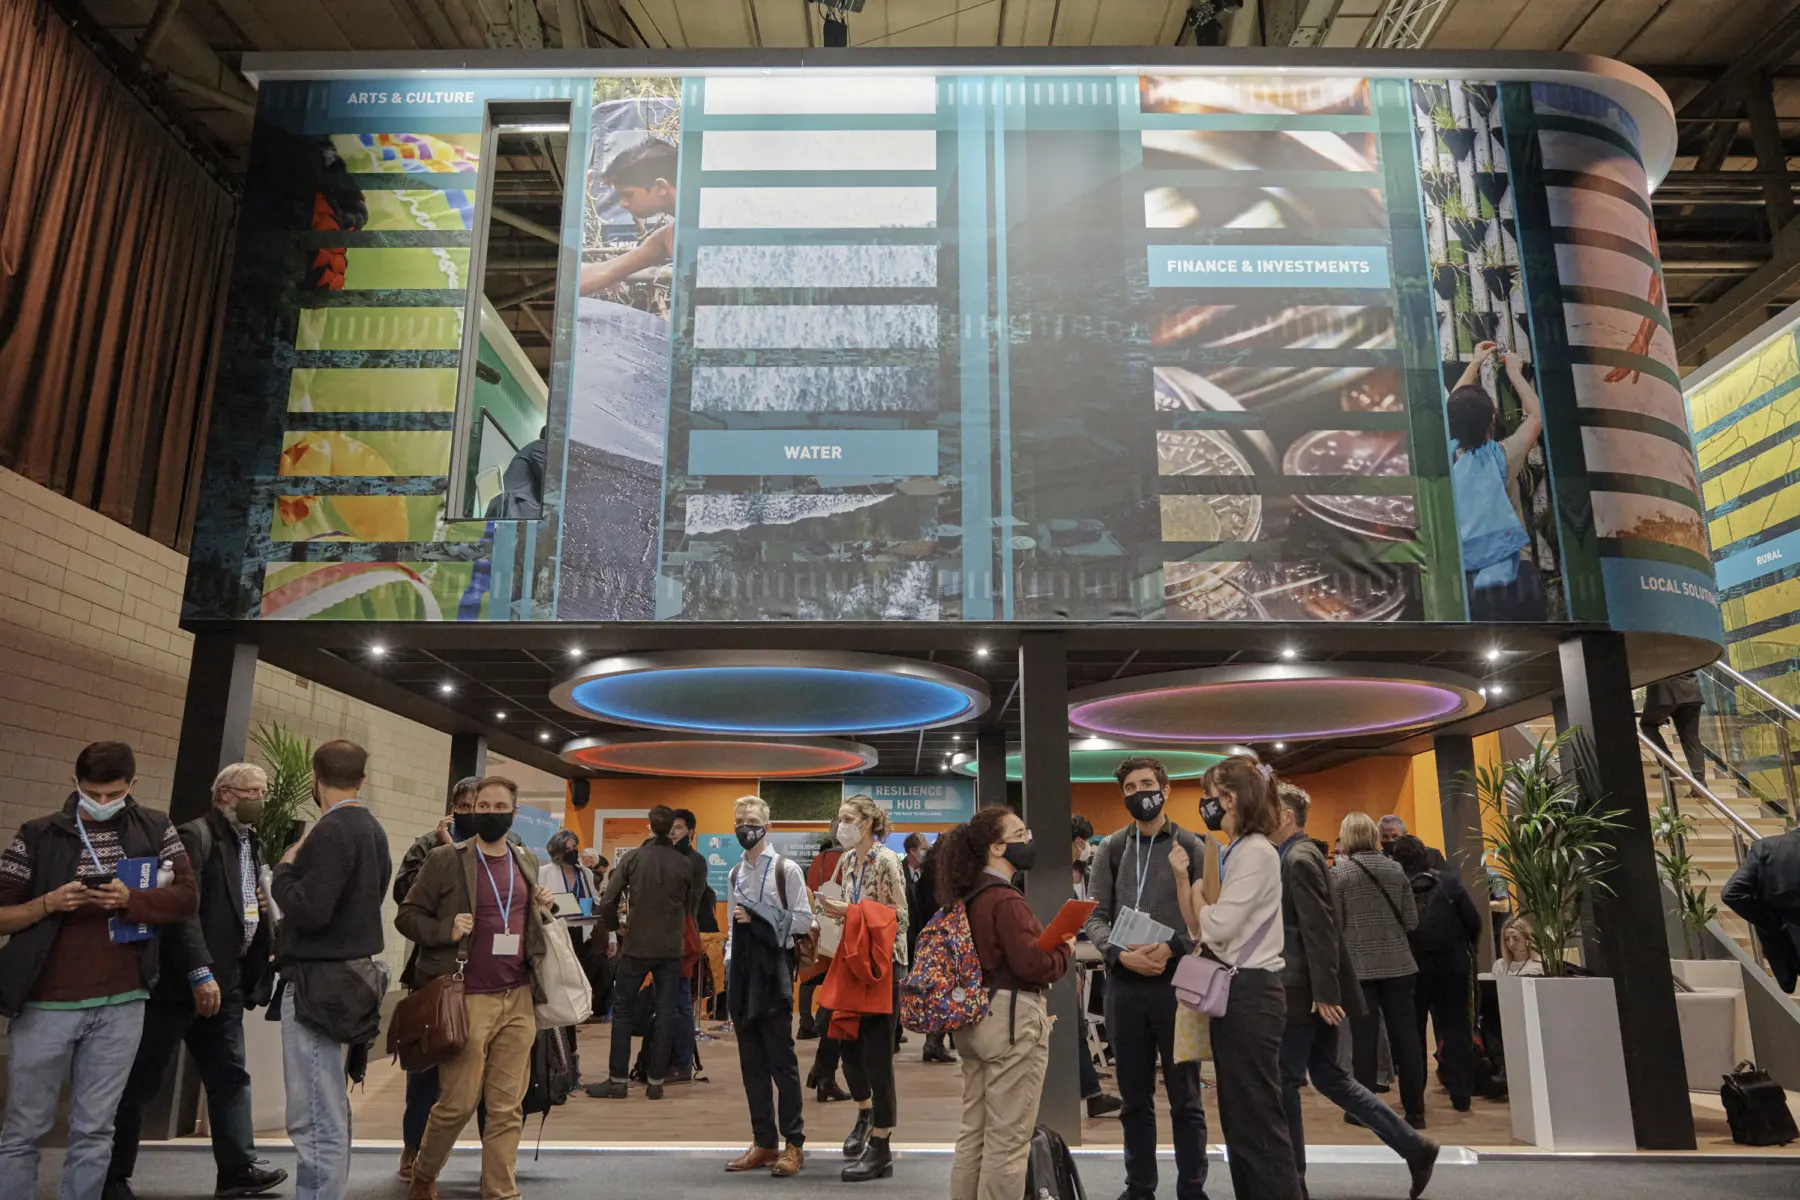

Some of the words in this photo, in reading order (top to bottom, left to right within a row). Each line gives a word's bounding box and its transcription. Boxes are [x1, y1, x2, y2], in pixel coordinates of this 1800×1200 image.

[347, 92, 388, 104] ARTS
[391, 92, 402, 104] &
[406, 91, 475, 104] CULTURE
[1167, 259, 1238, 273] FINANCE
[1242, 259, 1253, 273] &
[1257, 259, 1370, 273] INVESTMENTS
[783, 445, 842, 460] WATER
[1756, 549, 1783, 566] RURAL
[1640, 576, 1681, 594] LOCAL
[1682, 582, 1718, 608] SOLUTI
[876, 785, 943, 796] RESILIENCE
[896, 799, 921, 810] HUB
